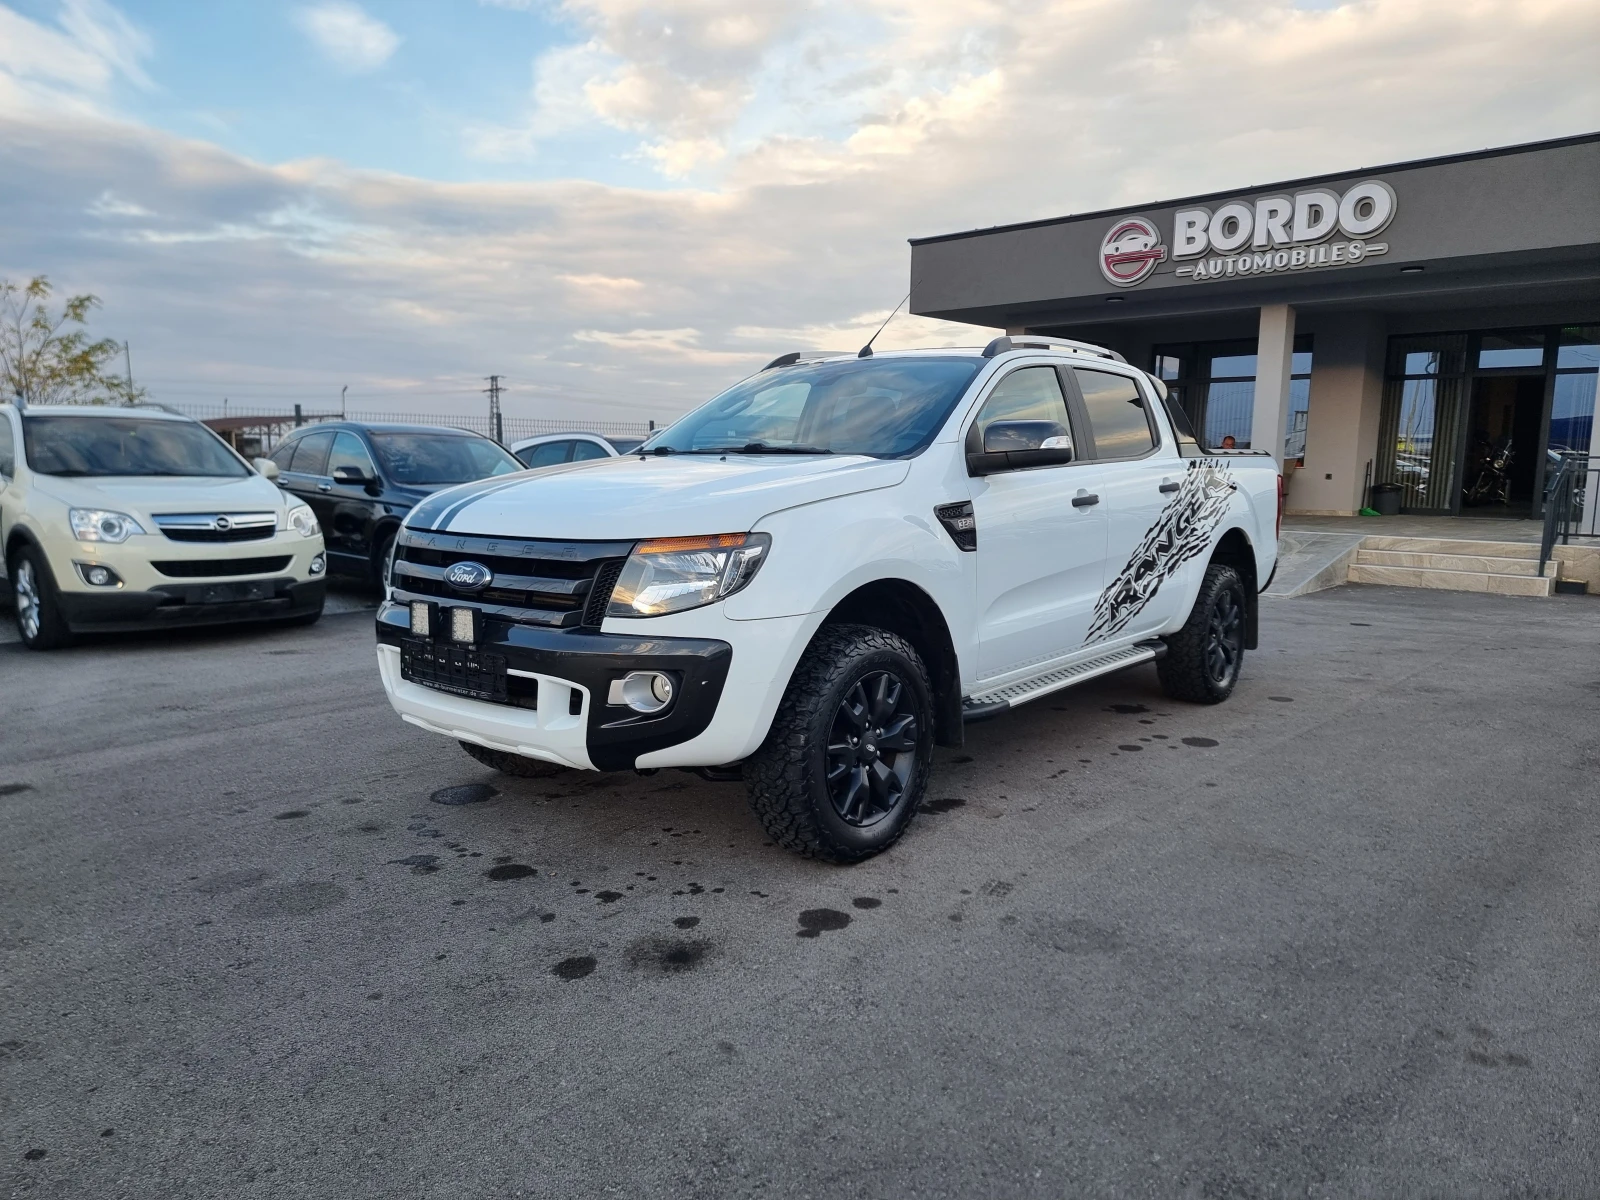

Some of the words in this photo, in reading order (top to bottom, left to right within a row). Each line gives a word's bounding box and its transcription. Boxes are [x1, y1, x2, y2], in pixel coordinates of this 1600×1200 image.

[1173, 182, 1392, 256] BORDO
[1193, 242, 1362, 277] AUTOMOBILES
[405, 534, 578, 558] RANGER
[450, 565, 477, 583] Ford
